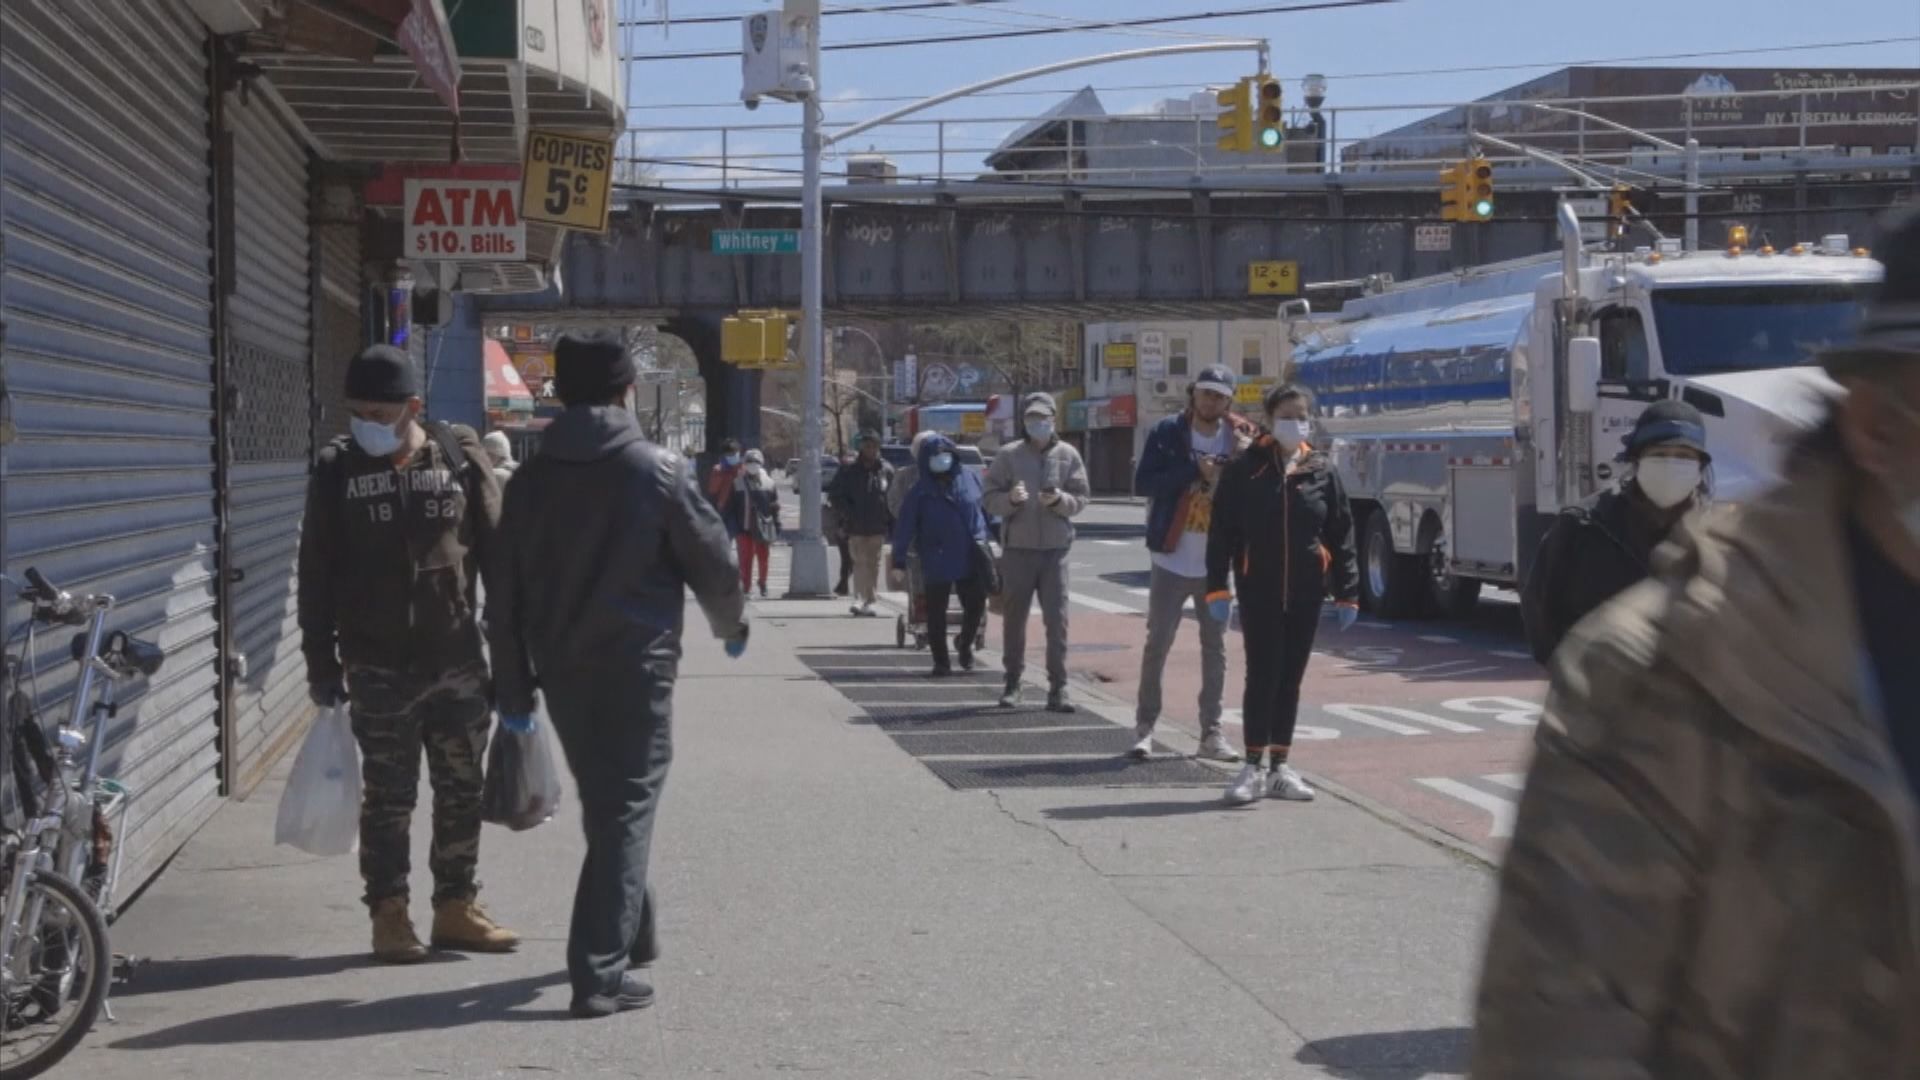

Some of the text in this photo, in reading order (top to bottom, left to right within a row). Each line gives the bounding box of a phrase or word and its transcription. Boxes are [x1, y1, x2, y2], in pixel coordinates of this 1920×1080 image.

[1764, 111, 1785, 125] NY
[1790, 111, 1850, 125] TBETAN
[532, 135, 606, 172] COPIES
[412, 187, 516, 227] ATM
[416, 230, 515, 254] $10. Bills
[718, 232, 778, 252] Whitney
[367, 500, 456, 523] 18 92
